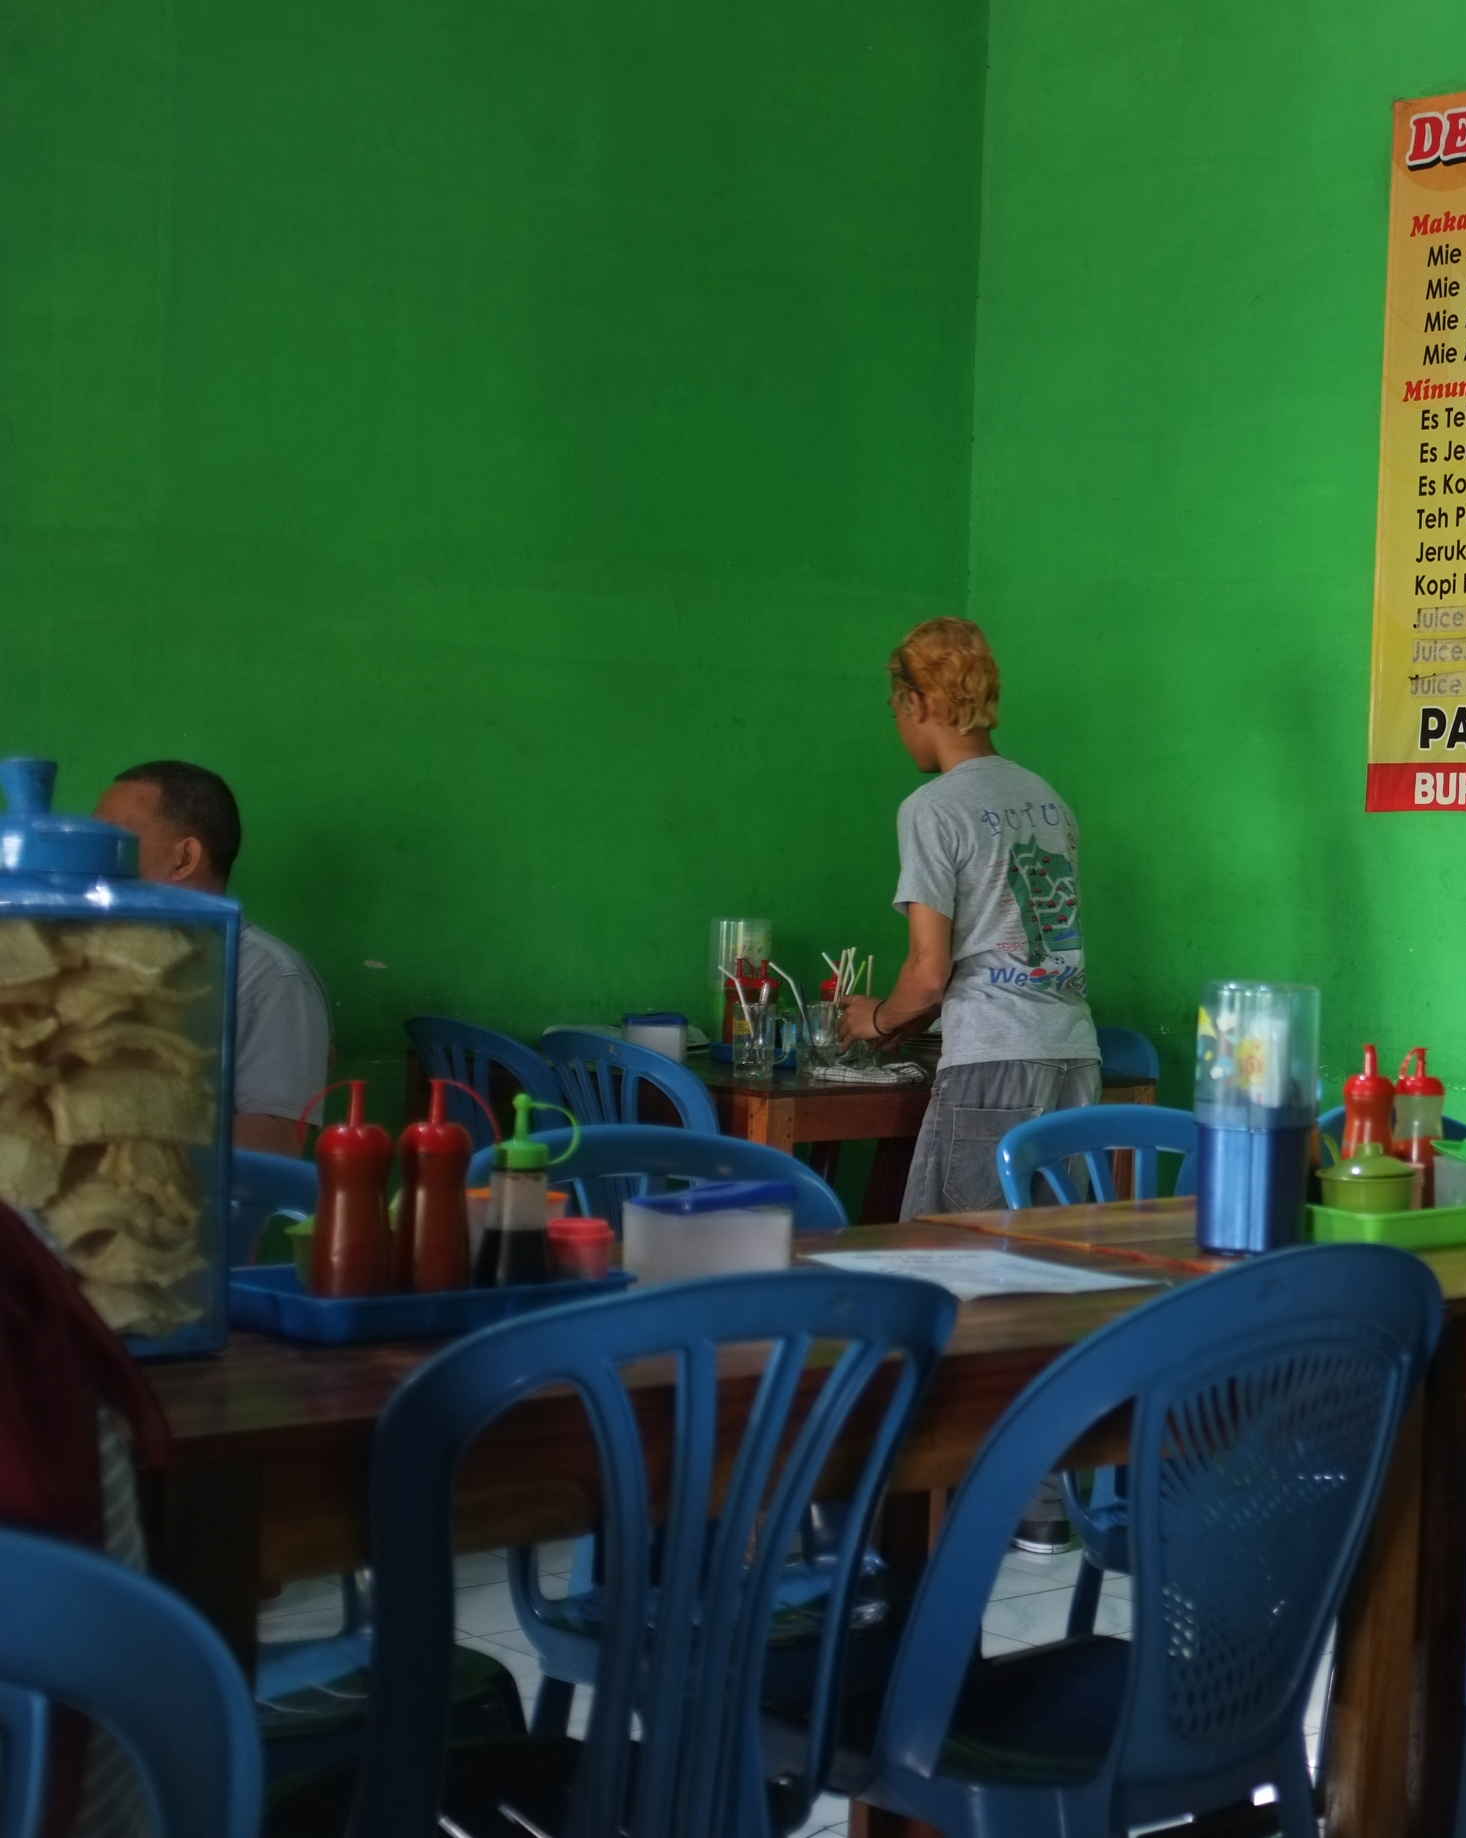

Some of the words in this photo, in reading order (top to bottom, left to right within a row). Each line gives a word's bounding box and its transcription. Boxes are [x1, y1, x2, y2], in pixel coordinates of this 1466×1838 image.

[1427, 246, 1462, 267] Mie
[1425, 278, 1460, 300] Mie
[1424, 312, 1459, 333] Mie
[1422, 345, 1458, 366] Mie
[1421, 409, 1439, 430] Es
[1419, 442, 1438, 464] Es
[1418, 476, 1436, 497] Es
[1416, 507, 1449, 530] Teh
[1414, 573, 1457, 600] Kopi
